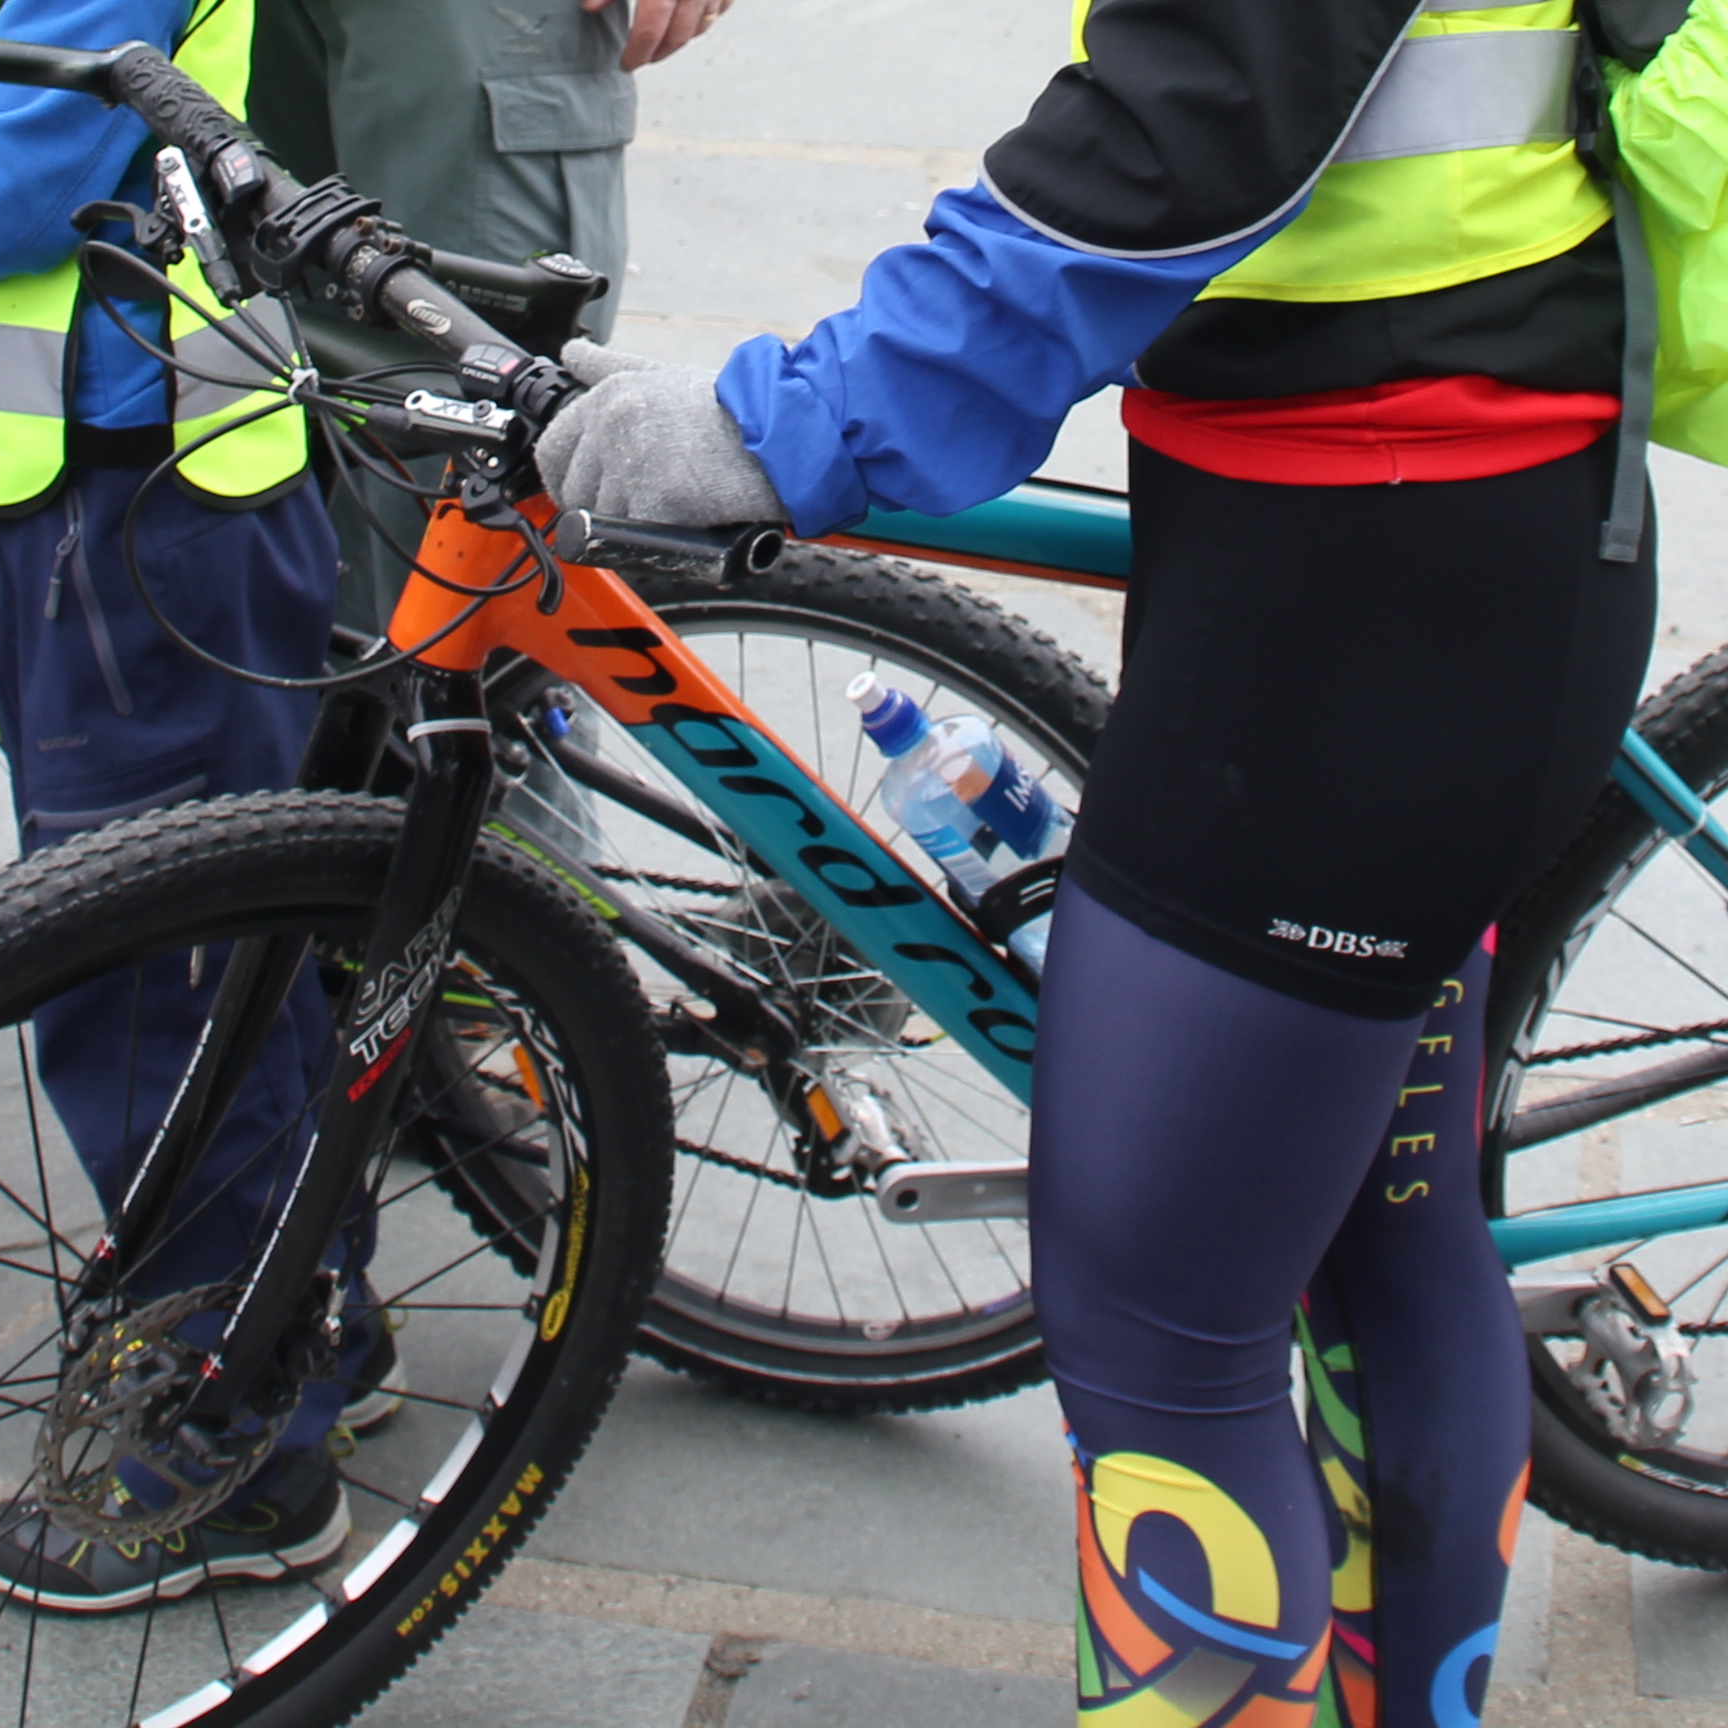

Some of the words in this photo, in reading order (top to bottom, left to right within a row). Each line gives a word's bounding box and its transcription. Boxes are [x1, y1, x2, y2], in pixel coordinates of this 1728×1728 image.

[1306, 925, 1377, 958] DBS
[891, 942, 1035, 1065] ro
[395, 1462, 545, 1638] MAXXIS.COM
